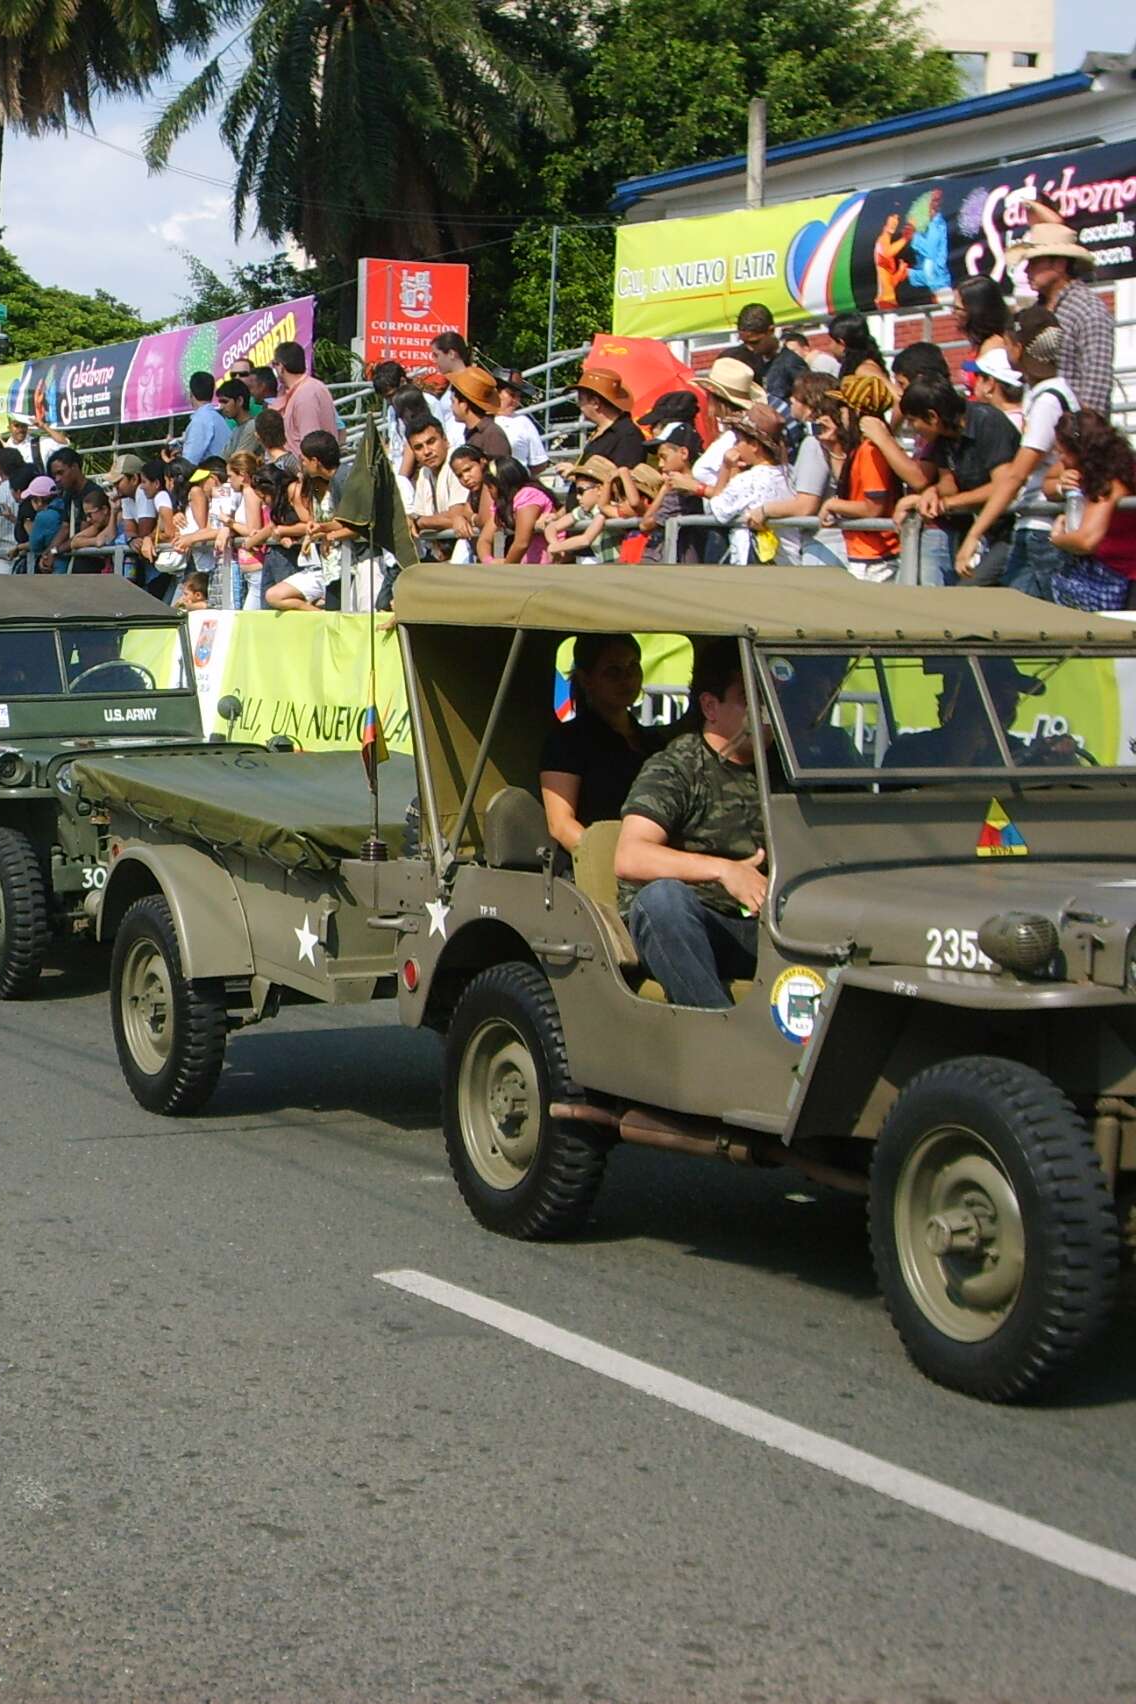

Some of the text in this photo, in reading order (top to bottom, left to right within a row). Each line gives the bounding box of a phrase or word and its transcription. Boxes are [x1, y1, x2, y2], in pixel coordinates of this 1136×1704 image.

[675, 259, 726, 288] NUEVO
[735, 252, 775, 281] LATIR
[371, 335, 432, 346] UNIVERSIT
[104, 708, 157, 721] U.S. ARMY
[271, 701, 306, 737] UN
